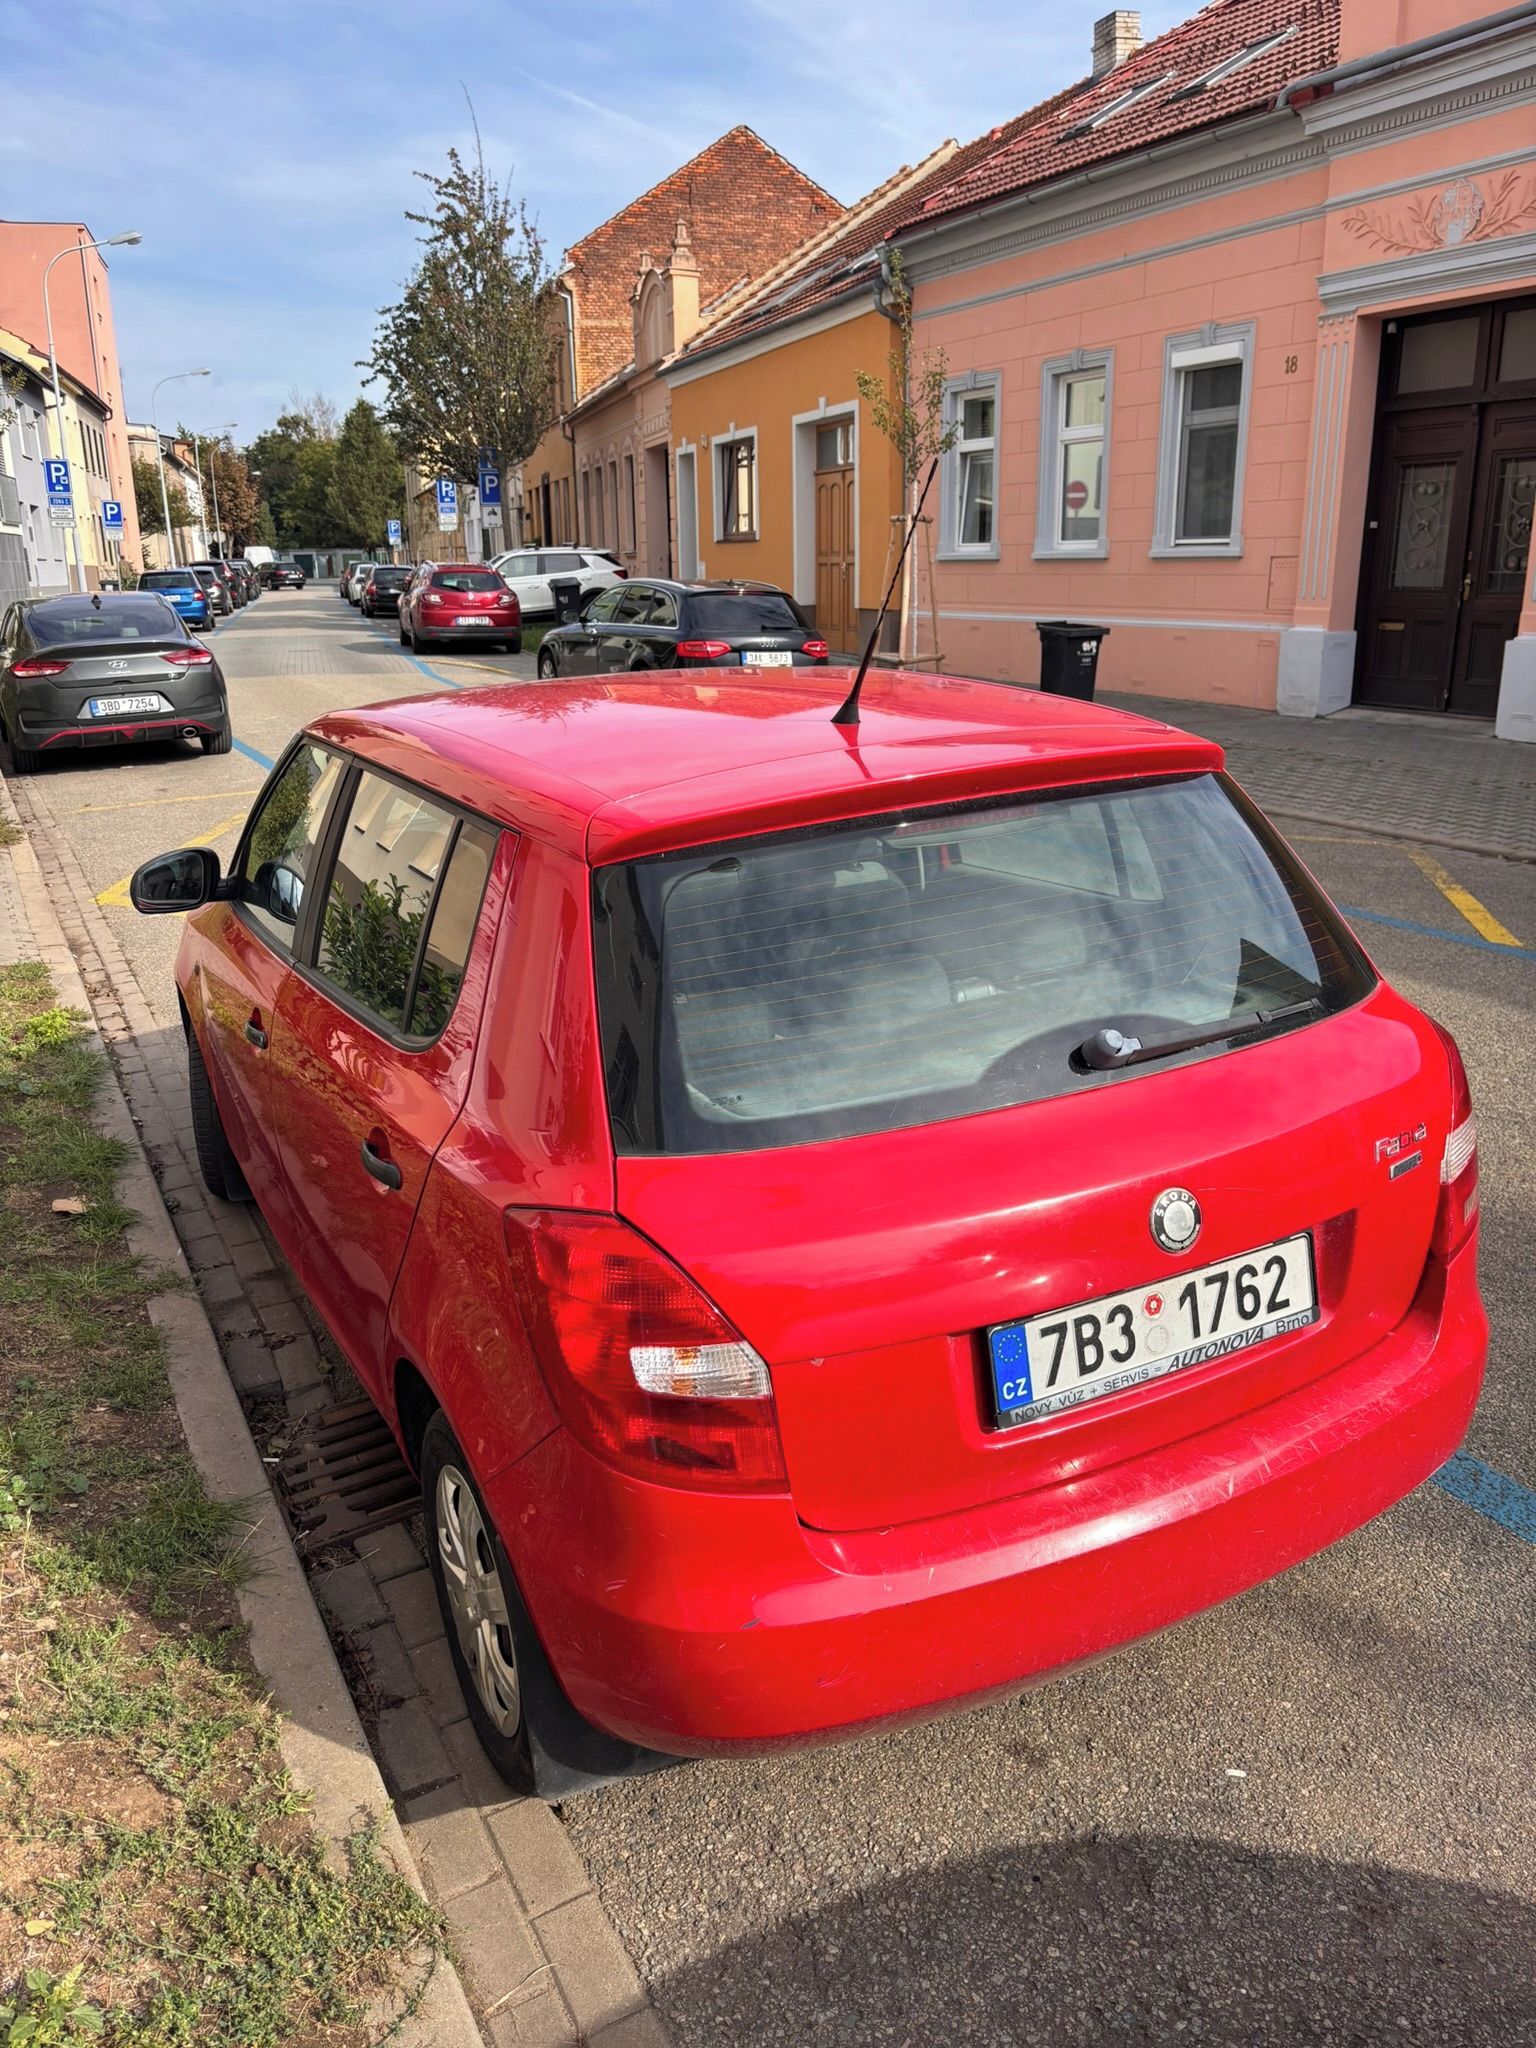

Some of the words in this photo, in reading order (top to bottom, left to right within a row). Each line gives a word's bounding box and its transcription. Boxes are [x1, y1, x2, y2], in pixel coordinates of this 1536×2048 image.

[1285, 355, 1298, 374] 18
[50, 463, 65, 483] P
[441, 481, 452, 496] P
[485, 476, 498, 495] P
[106, 504, 118, 520] P
[391, 522, 398, 533] P
[101, 701, 120, 712] 3BD
[128, 698, 154, 710] 7254
[1040, 1303, 1136, 1388] 7B3
[1178, 1255, 1290, 1340] 1762
[1015, 1398, 1051, 1422] NOVÝ
[1104, 1368, 1149, 1392] SERVIS
[1168, 1327, 1265, 1371] AUTONOVA
[1276, 1314, 1310, 1335] Brno
[1002, 1377, 1027, 1400] CZ
